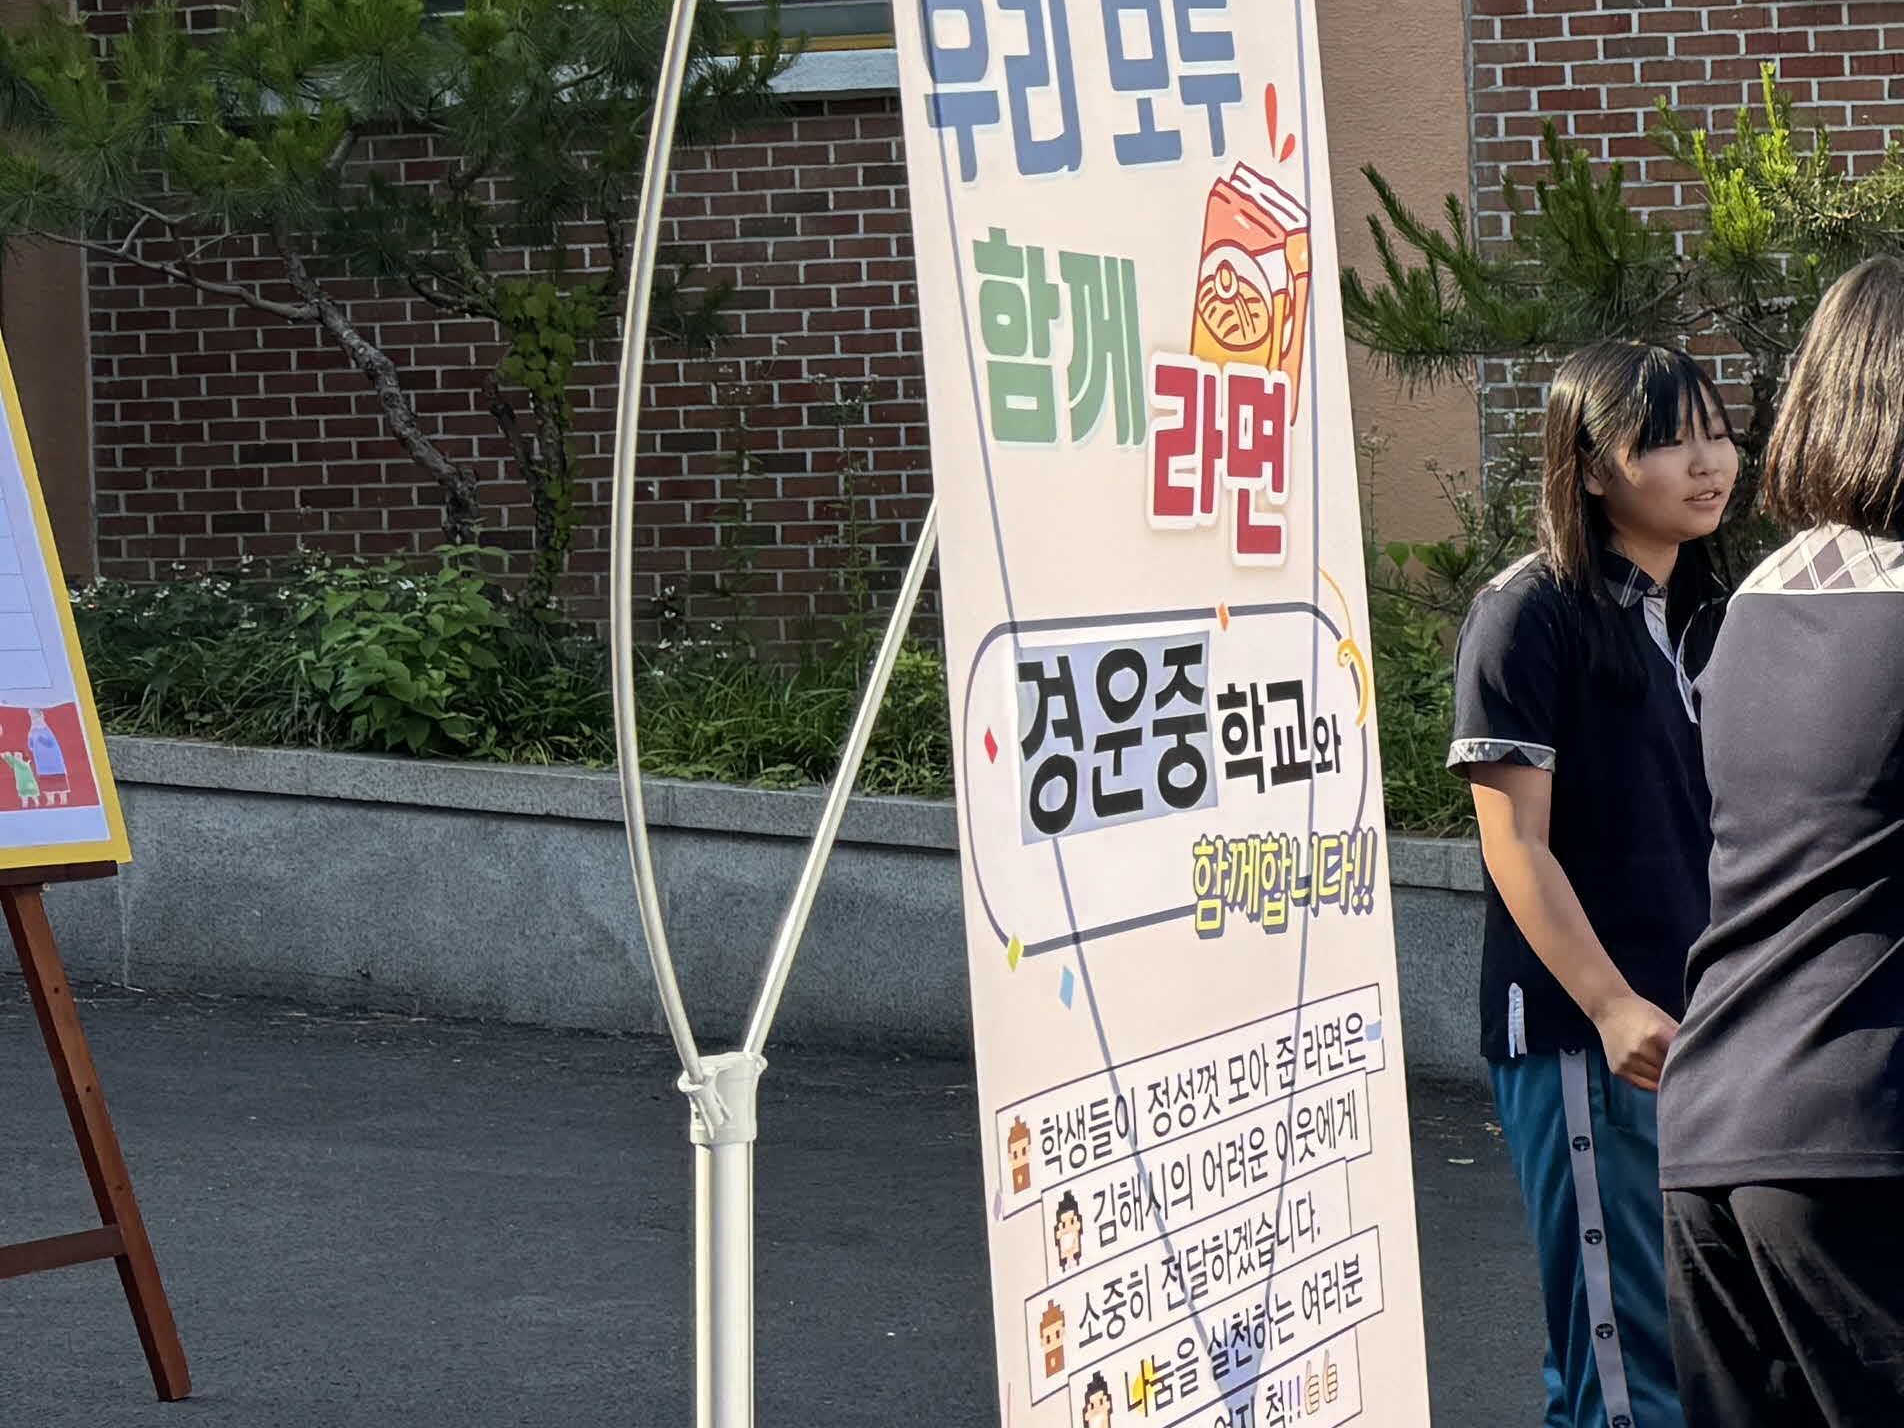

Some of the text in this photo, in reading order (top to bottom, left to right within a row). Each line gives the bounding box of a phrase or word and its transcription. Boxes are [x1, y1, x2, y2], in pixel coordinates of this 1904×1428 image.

[1016, 642, 1343, 836] 경운중학교와
[1192, 826, 1378, 939] 함께합니다!!
[1040, 1012, 1367, 1176] 학생들이 정성껏 모아 준 라면은
[1092, 1088, 1359, 1248] 김해시의 어려운 이웃에게
[1078, 1190, 1321, 1349] 소중히 전달하겠습니다.
[1124, 1253, 1364, 1418] 나눔을 실천하는 여러분
